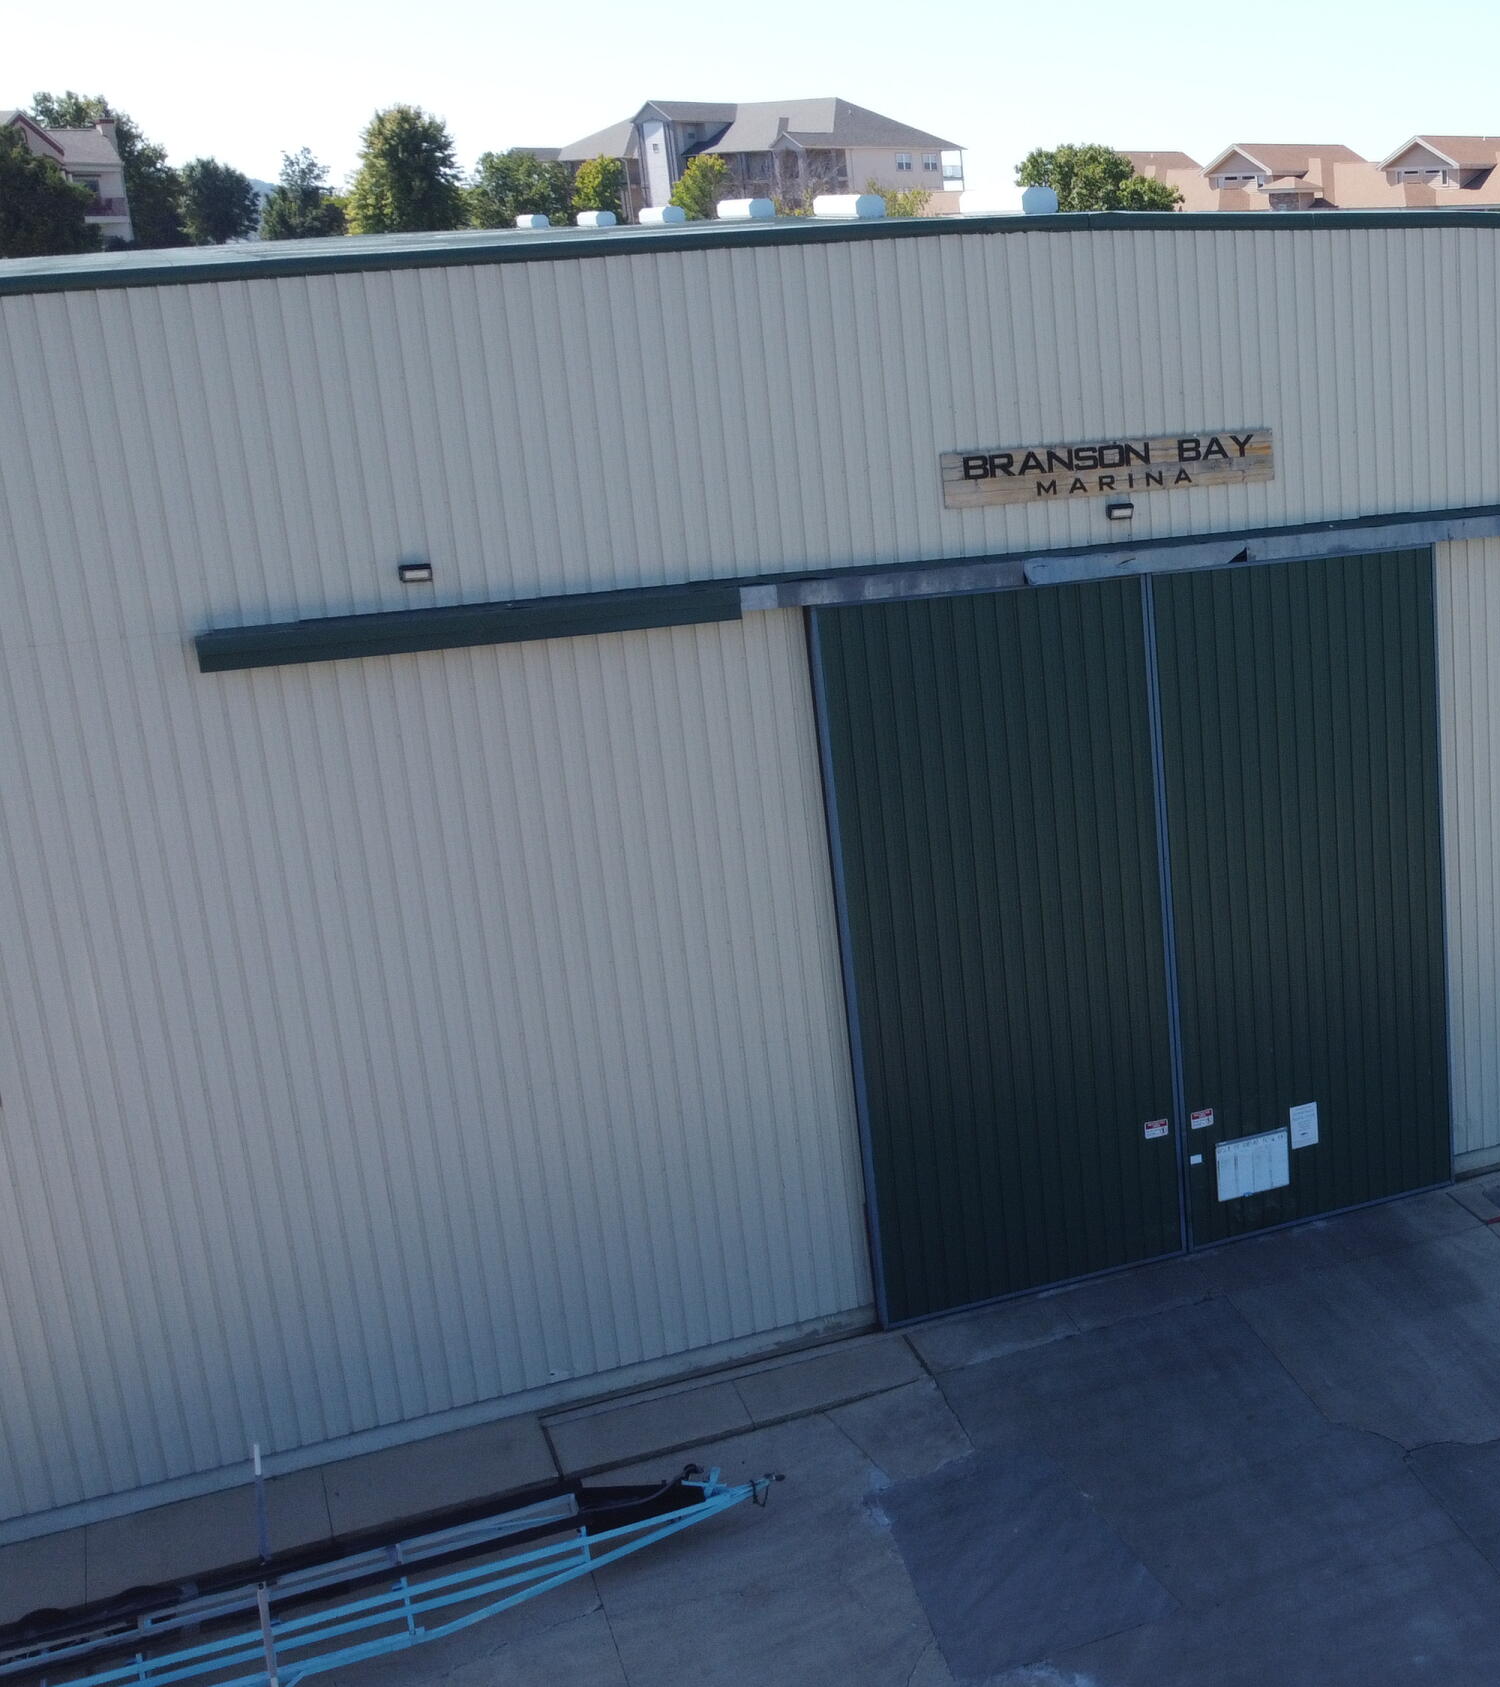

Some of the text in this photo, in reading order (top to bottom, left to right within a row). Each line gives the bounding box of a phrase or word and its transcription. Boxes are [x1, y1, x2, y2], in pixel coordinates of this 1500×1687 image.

[962, 434, 1254, 480] BRANSON BAY
[1036, 468, 1192, 497] MARINA
